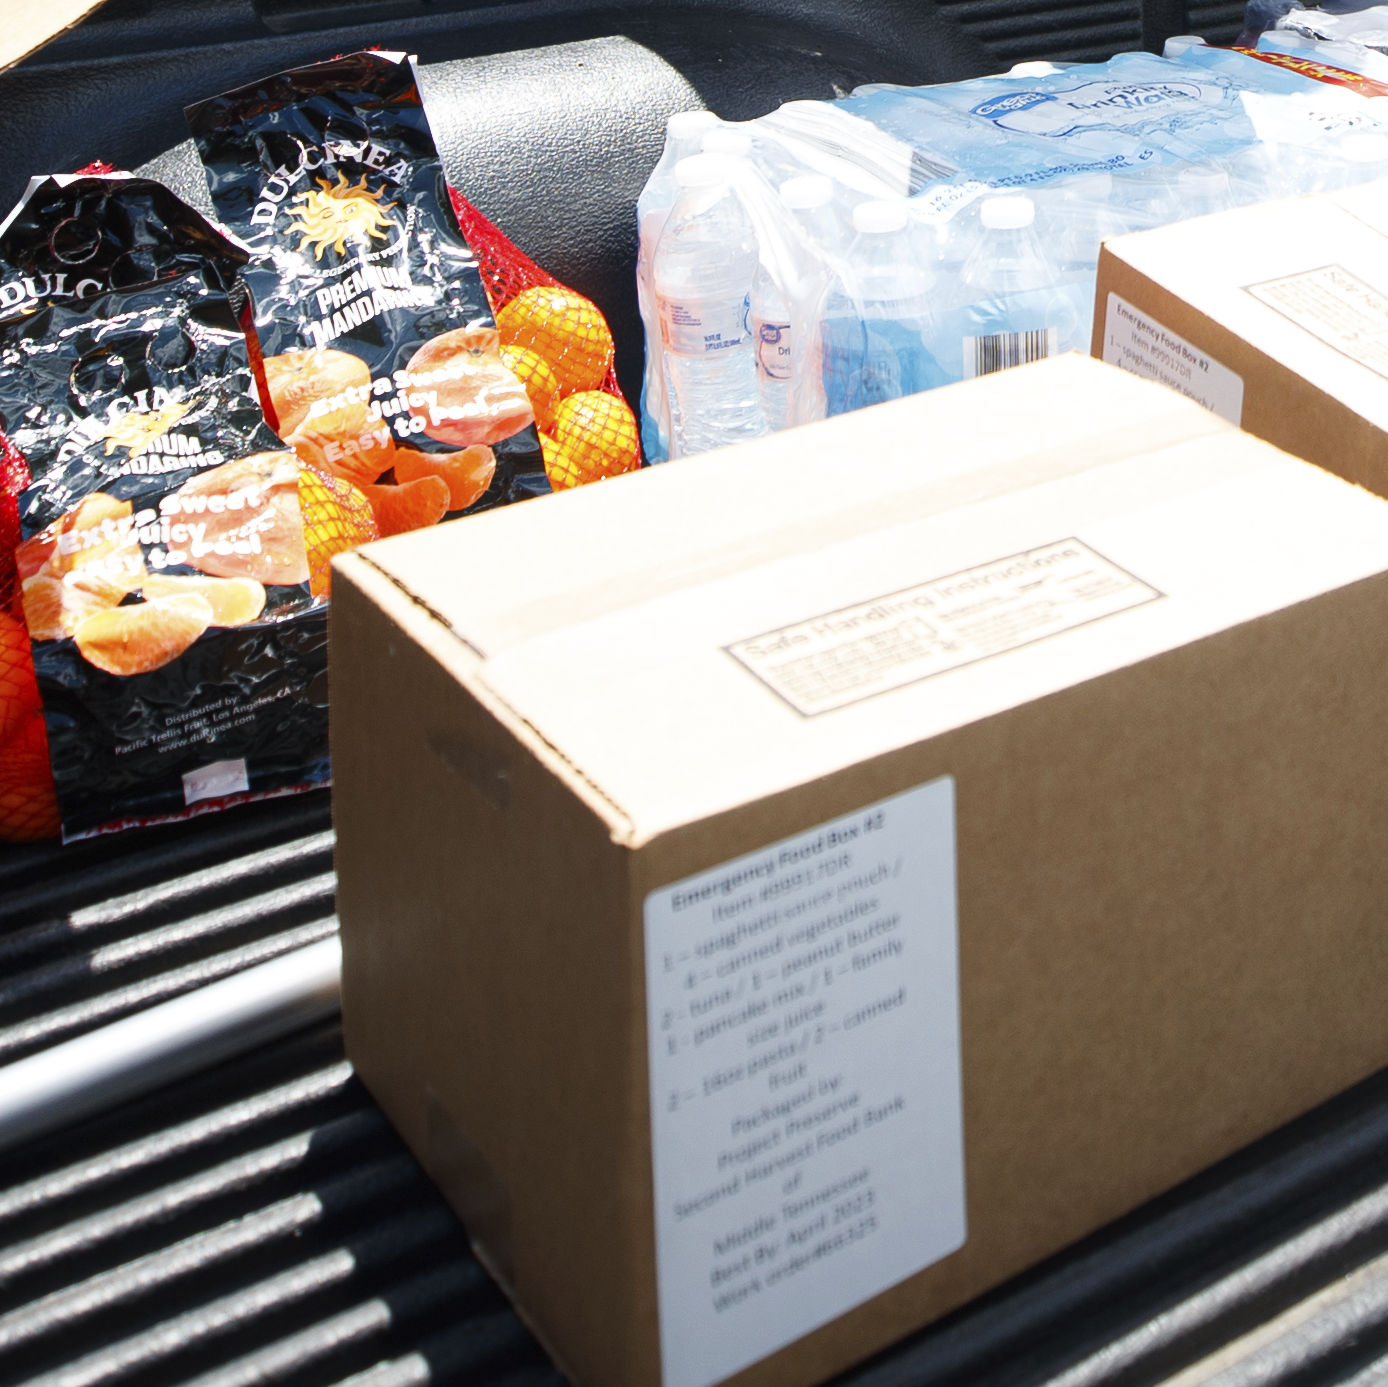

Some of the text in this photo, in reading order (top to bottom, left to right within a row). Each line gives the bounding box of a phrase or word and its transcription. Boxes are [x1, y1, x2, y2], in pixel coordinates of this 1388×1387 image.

[250, 139, 409, 225] DULCINEA
[311, 287, 435, 352] MANDARINS
[316, 265, 413, 314] PREMIUM
[1116, 303, 1210, 373] Emergency Food Box #2
[1122, 345, 1182, 393] spaghetti sauce
[1131, 331, 1149, 352] Item
[310, 363, 477, 418] Extra Sweet
[365, 390, 438, 423] Juicy
[323, 415, 427, 462] Easy to
[56, 485, 262, 555] Extra Sweet
[120, 516, 207, 547] Juicy
[147, 546, 188, 570] to
[743, 629, 811, 660] Safe
[812, 593, 937, 639] Handling
[932, 545, 1082, 601] Instructions
[115, 738, 148, 756] Pacific
[150, 727, 182, 744] Trellis
[212, 710, 230, 722] Los
[277, 686, 292, 699] CA
[165, 699, 222, 726] Distributed
[671, 811, 886, 913] Emergency Food Box #2
[694, 862, 891, 961] spaghetti sauce pouch
[713, 892, 755, 924] Item
[716, 895, 881, 979] canned vegetables
[689, 936, 845, 1017] tuna peanut
[694, 937, 904, 1049] pancake mix family
[747, 999, 826, 1048] size juice
[747, 1041, 800, 1079] pasta
[842, 986, 908, 1031] canned
[768, 1059, 807, 1093] fruit
[717, 1090, 861, 1172] Project Preserve
[730, 1084, 815, 1138] Packaged
[673, 1094, 906, 1222] Second Harvest Food Bank
[781, 1168, 803, 1197] of
[714, 1166, 870, 1258] Middle Tennessee
[710, 1255, 751, 1289] Best
[785, 1214, 827, 1249] April
[713, 1276, 762, 1314] Work
